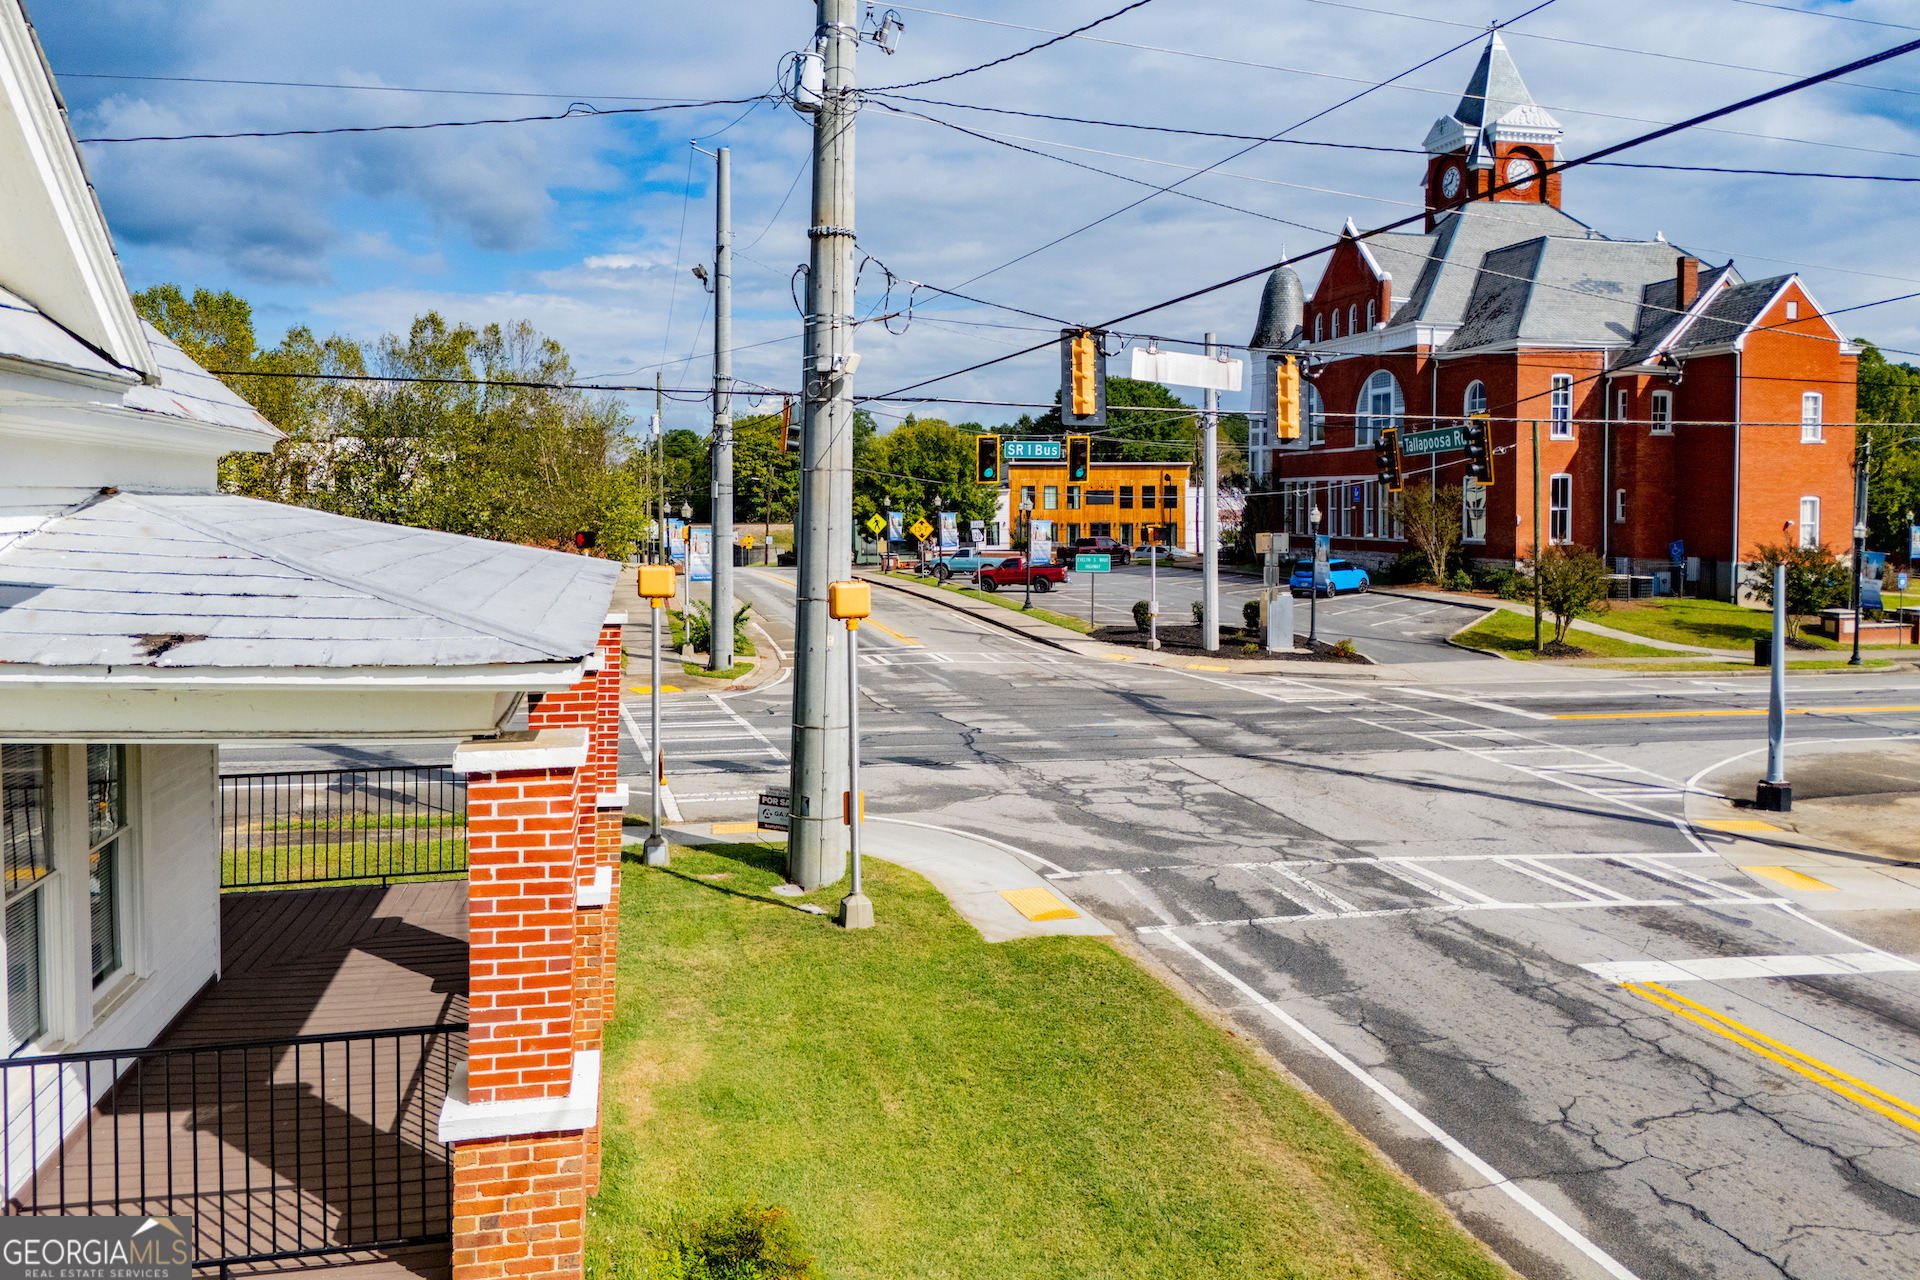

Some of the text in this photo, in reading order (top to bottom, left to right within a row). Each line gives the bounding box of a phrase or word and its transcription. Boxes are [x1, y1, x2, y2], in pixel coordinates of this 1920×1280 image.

[1404, 434, 1451, 453] Tallapoosa
[1008, 444, 1023, 455] SR
[1035, 444, 1057, 455] Bus
[973, 531, 981, 540] 120
[762, 796, 789, 807] FOR SA
